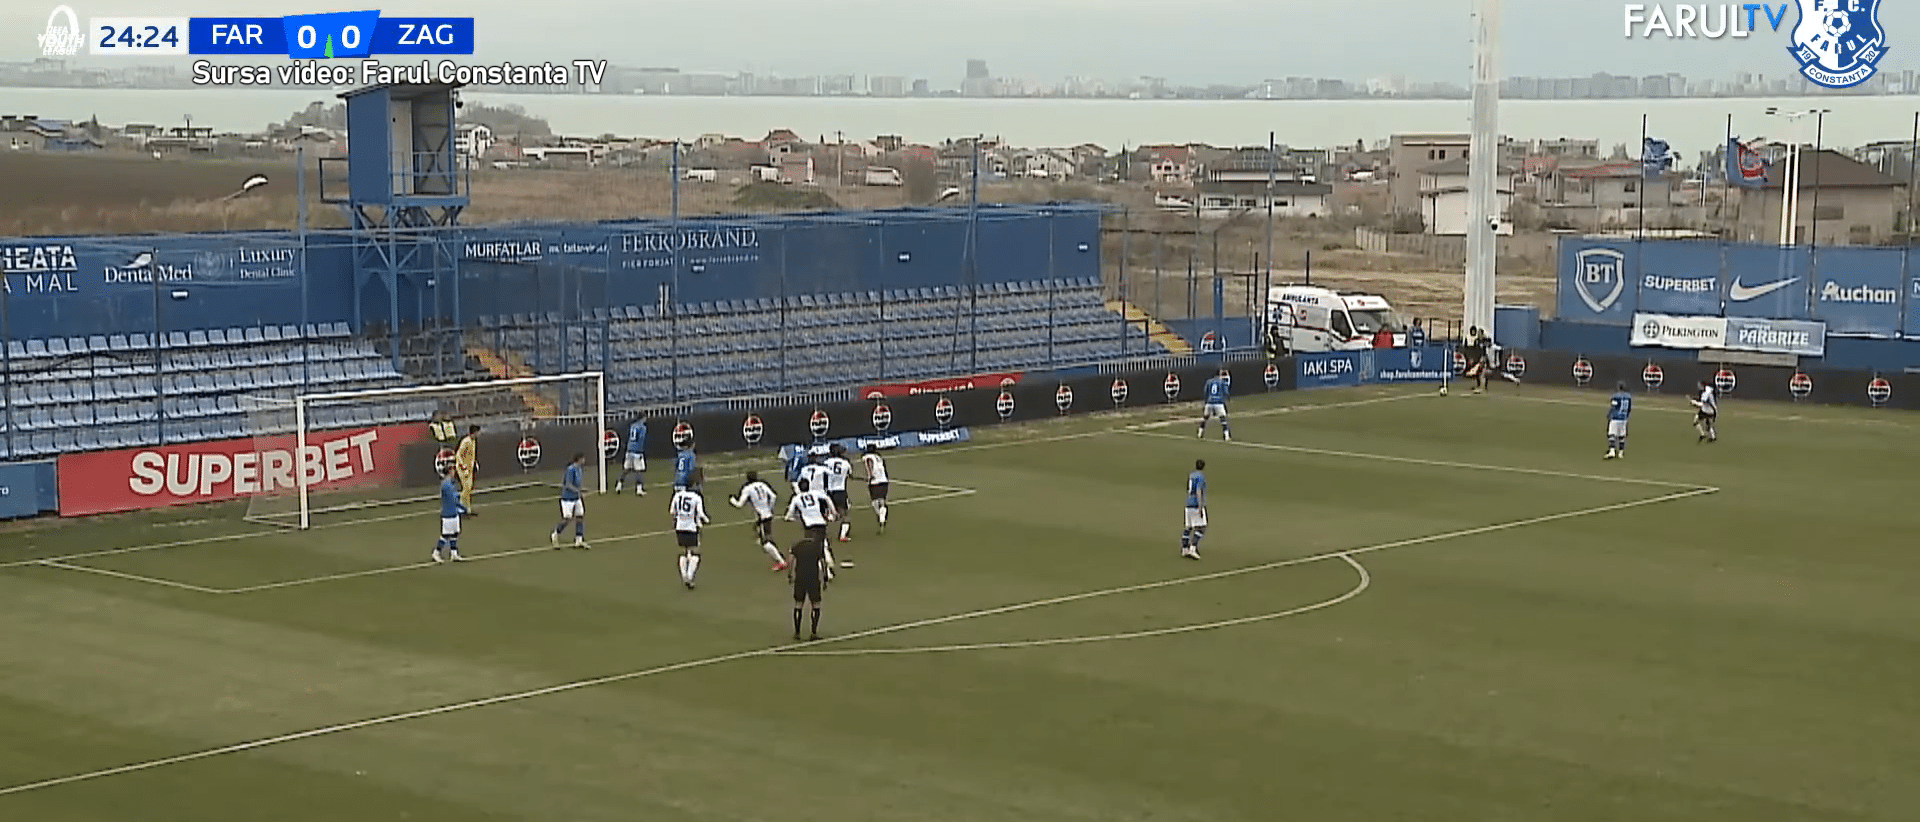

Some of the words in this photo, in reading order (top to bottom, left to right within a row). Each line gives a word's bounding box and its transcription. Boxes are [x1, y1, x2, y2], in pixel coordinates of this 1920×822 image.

[465, 240, 541, 258] MURFATLAR
[240, 247, 296, 270] Luxury
[1586, 263, 1615, 284] BT
[26, 272, 78, 294] MAL
[1644, 275, 1716, 293] SUPERBET
[1821, 280, 1896, 304] Auchan
[1739, 329, 1809, 346] PARBRIZE
[1303, 361, 1327, 376] IAKI
[1330, 358, 1353, 373] SPA
[129, 430, 379, 497] SUPERBET
[834, 461, 842, 475] 6
[807, 468, 816, 481] 7
[678, 495, 691, 512] 16
[801, 494, 814, 509] 19
